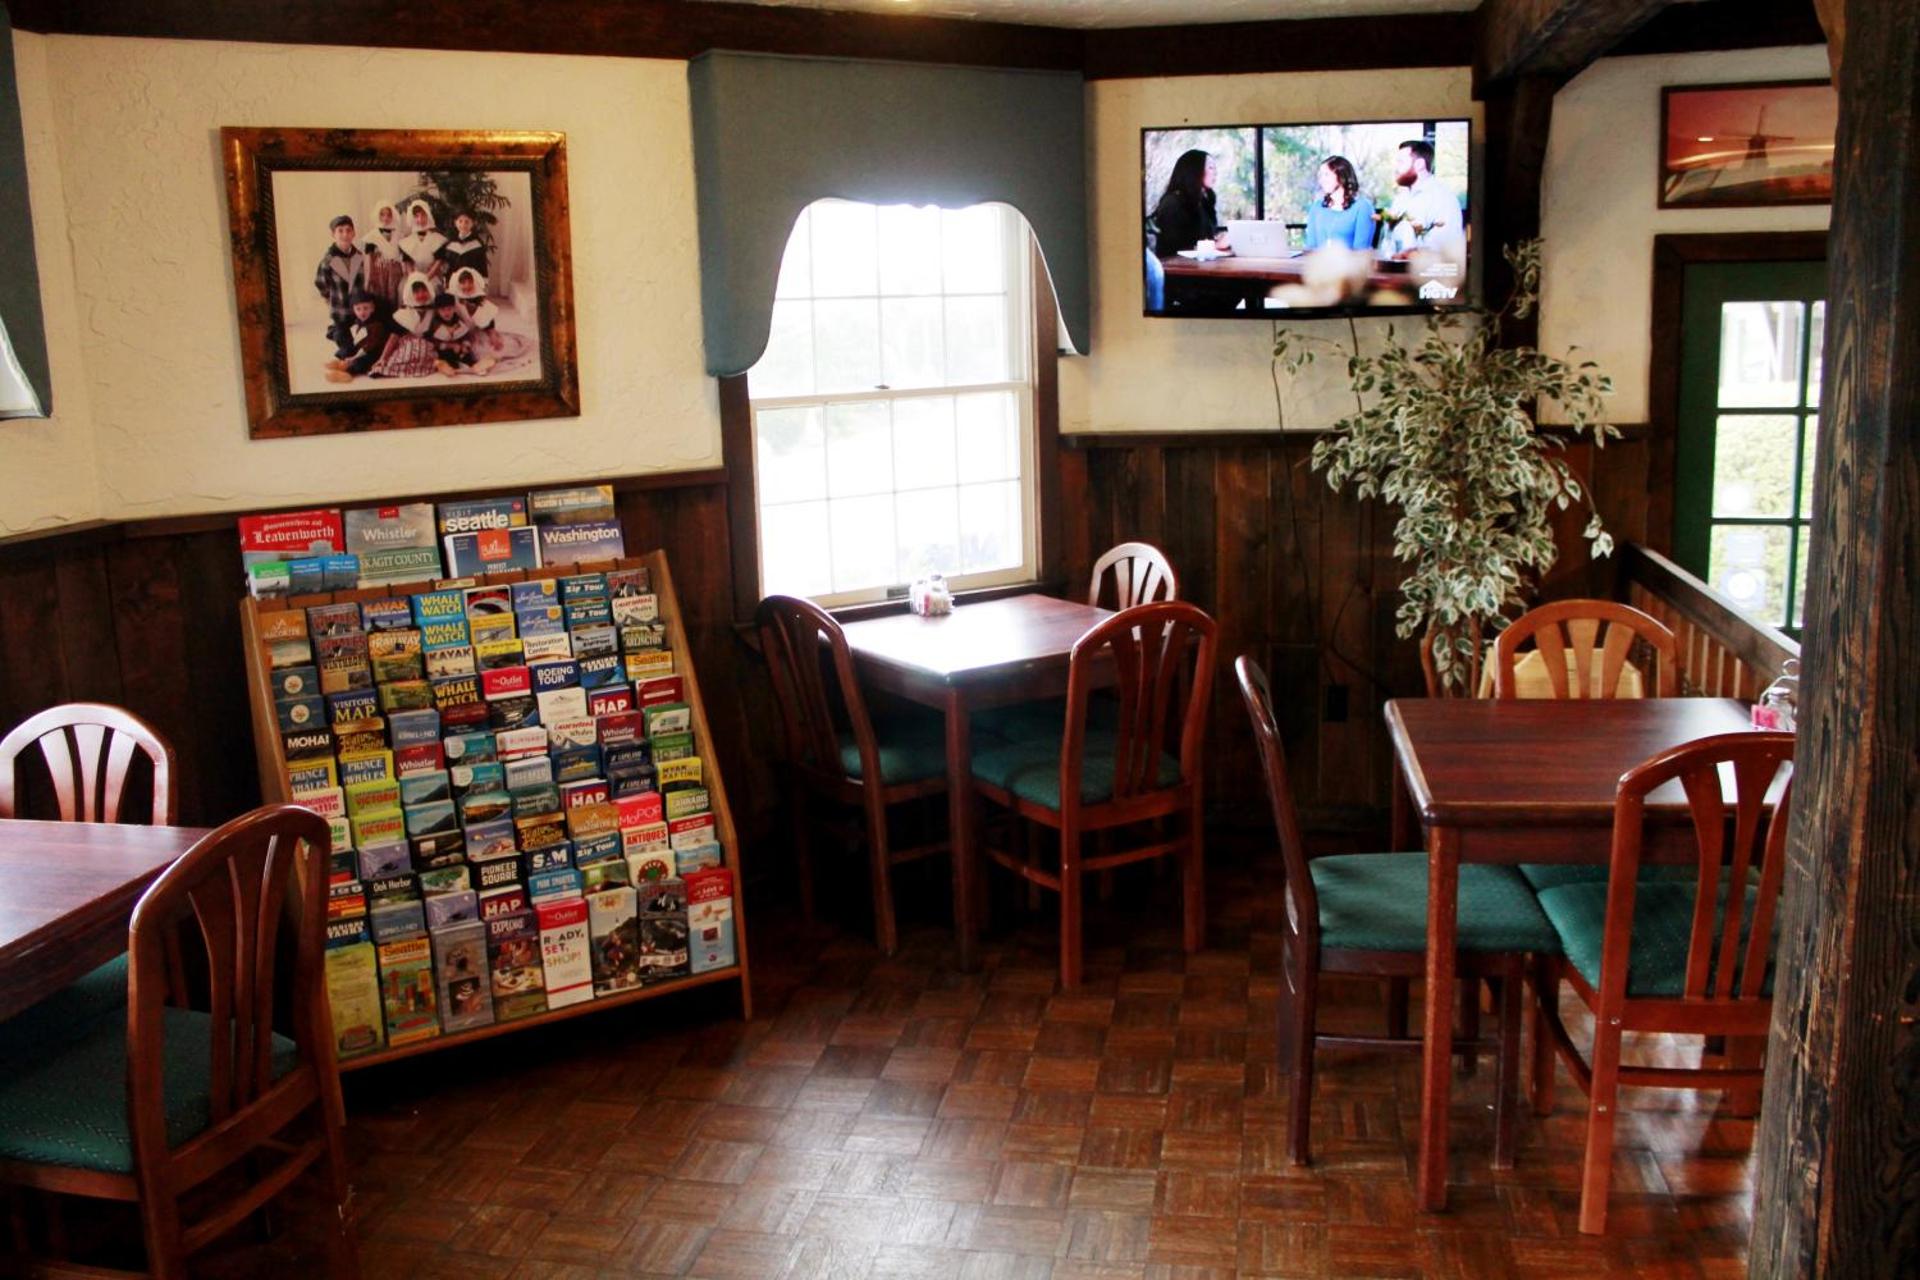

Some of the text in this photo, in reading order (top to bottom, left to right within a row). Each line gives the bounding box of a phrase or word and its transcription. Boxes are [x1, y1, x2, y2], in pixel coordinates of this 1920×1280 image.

[446, 509, 509, 532] seattle
[253, 526, 335, 544] Leavenworth
[362, 526, 416, 541] Whistler
[543, 527, 620, 544] Washington
[395, 552, 433, 565] COUNTY
[421, 593, 461, 606] WHALE
[421, 603, 462, 616] WATCH
[424, 621, 464, 634] WHALE
[425, 631, 466, 645] WATCH
[429, 647, 472, 660] KAYAK
[537, 665, 574, 679] BOEING
[500, 675, 522, 685] Outlet
[539, 675, 566, 685] TOUR
[434, 680, 477, 696] WHALE
[334, 697, 376, 709] VISITORS
[436, 691, 479, 708] WATCH
[594, 699, 628, 715] MAP
[336, 705, 376, 722] MAP
[603, 727, 635, 737] Whistler
[288, 734, 330, 748] MOHAI
[347, 759, 382, 774] PRINCE
[400, 759, 436, 770] Whistler
[345, 770, 386, 785] WHALES
[572, 792, 606, 808] MAP
[361, 821, 402, 836] VICTORIA
[626, 829, 667, 845] ANTIQUES
[533, 848, 568, 868] SAM
[481, 861, 517, 876] PIONEER
[373, 882, 388, 892] Oak
[389, 878, 412, 889] Harbor
[482, 871, 518, 886] SQUARE
[486, 899, 521, 917] MAP
[384, 942, 427, 956] Seattle
